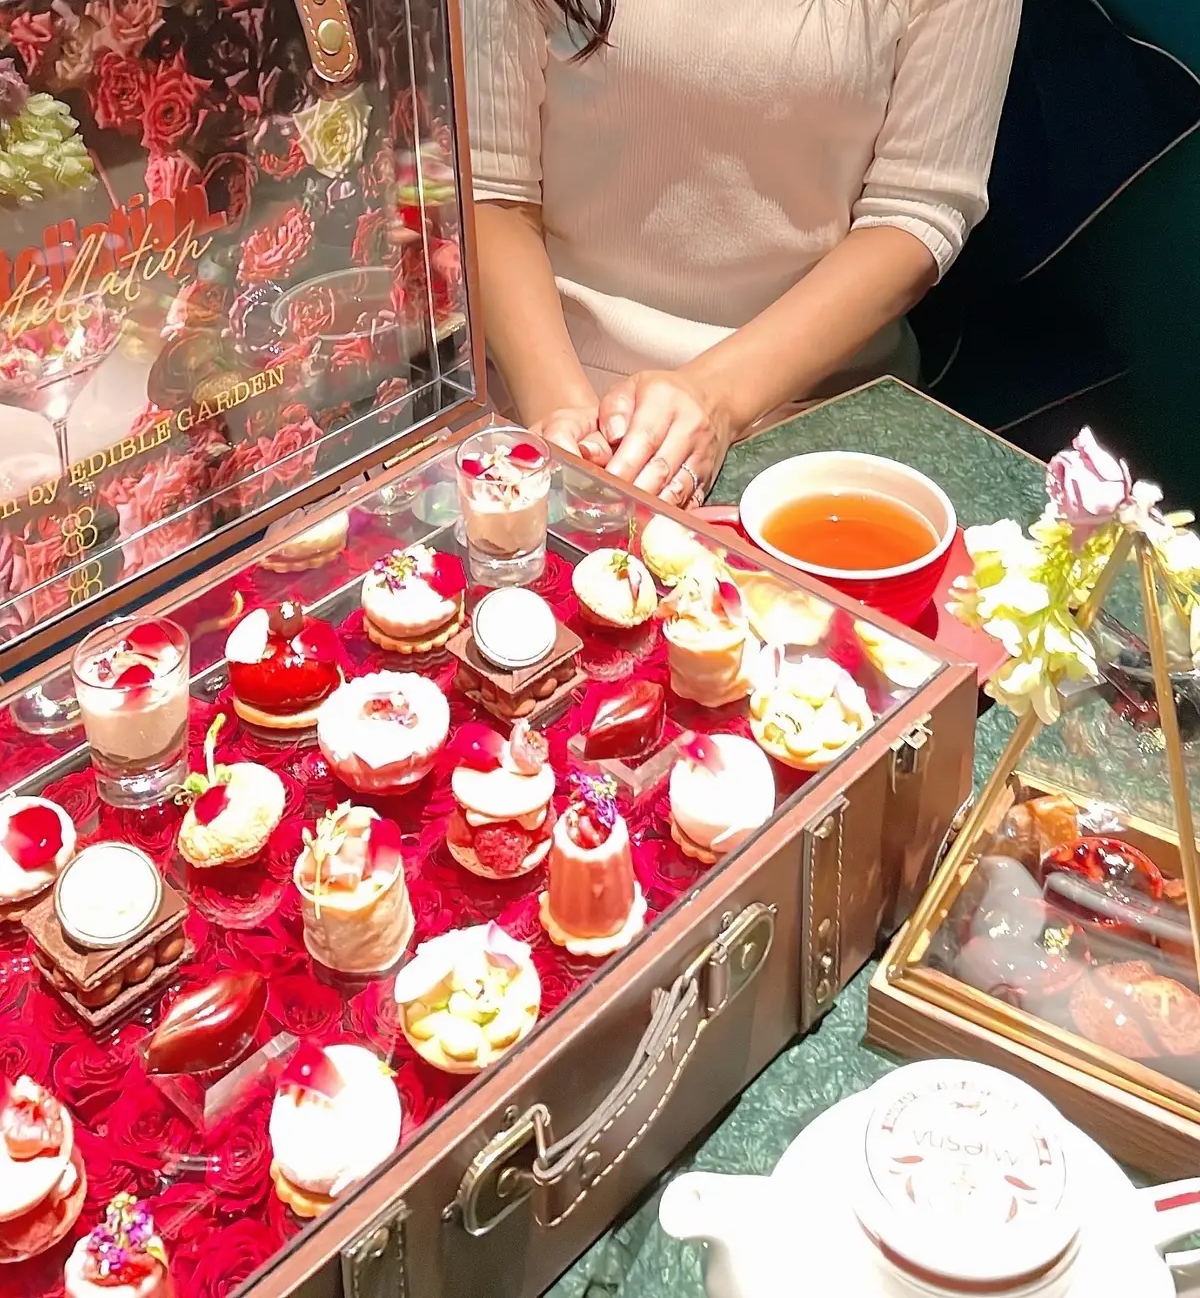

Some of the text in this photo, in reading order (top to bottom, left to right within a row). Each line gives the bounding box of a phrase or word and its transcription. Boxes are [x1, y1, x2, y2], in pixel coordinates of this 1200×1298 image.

[0, 218, 214, 341] tellation
[0, 364, 286, 520] n by EDIBLE GARDEN
